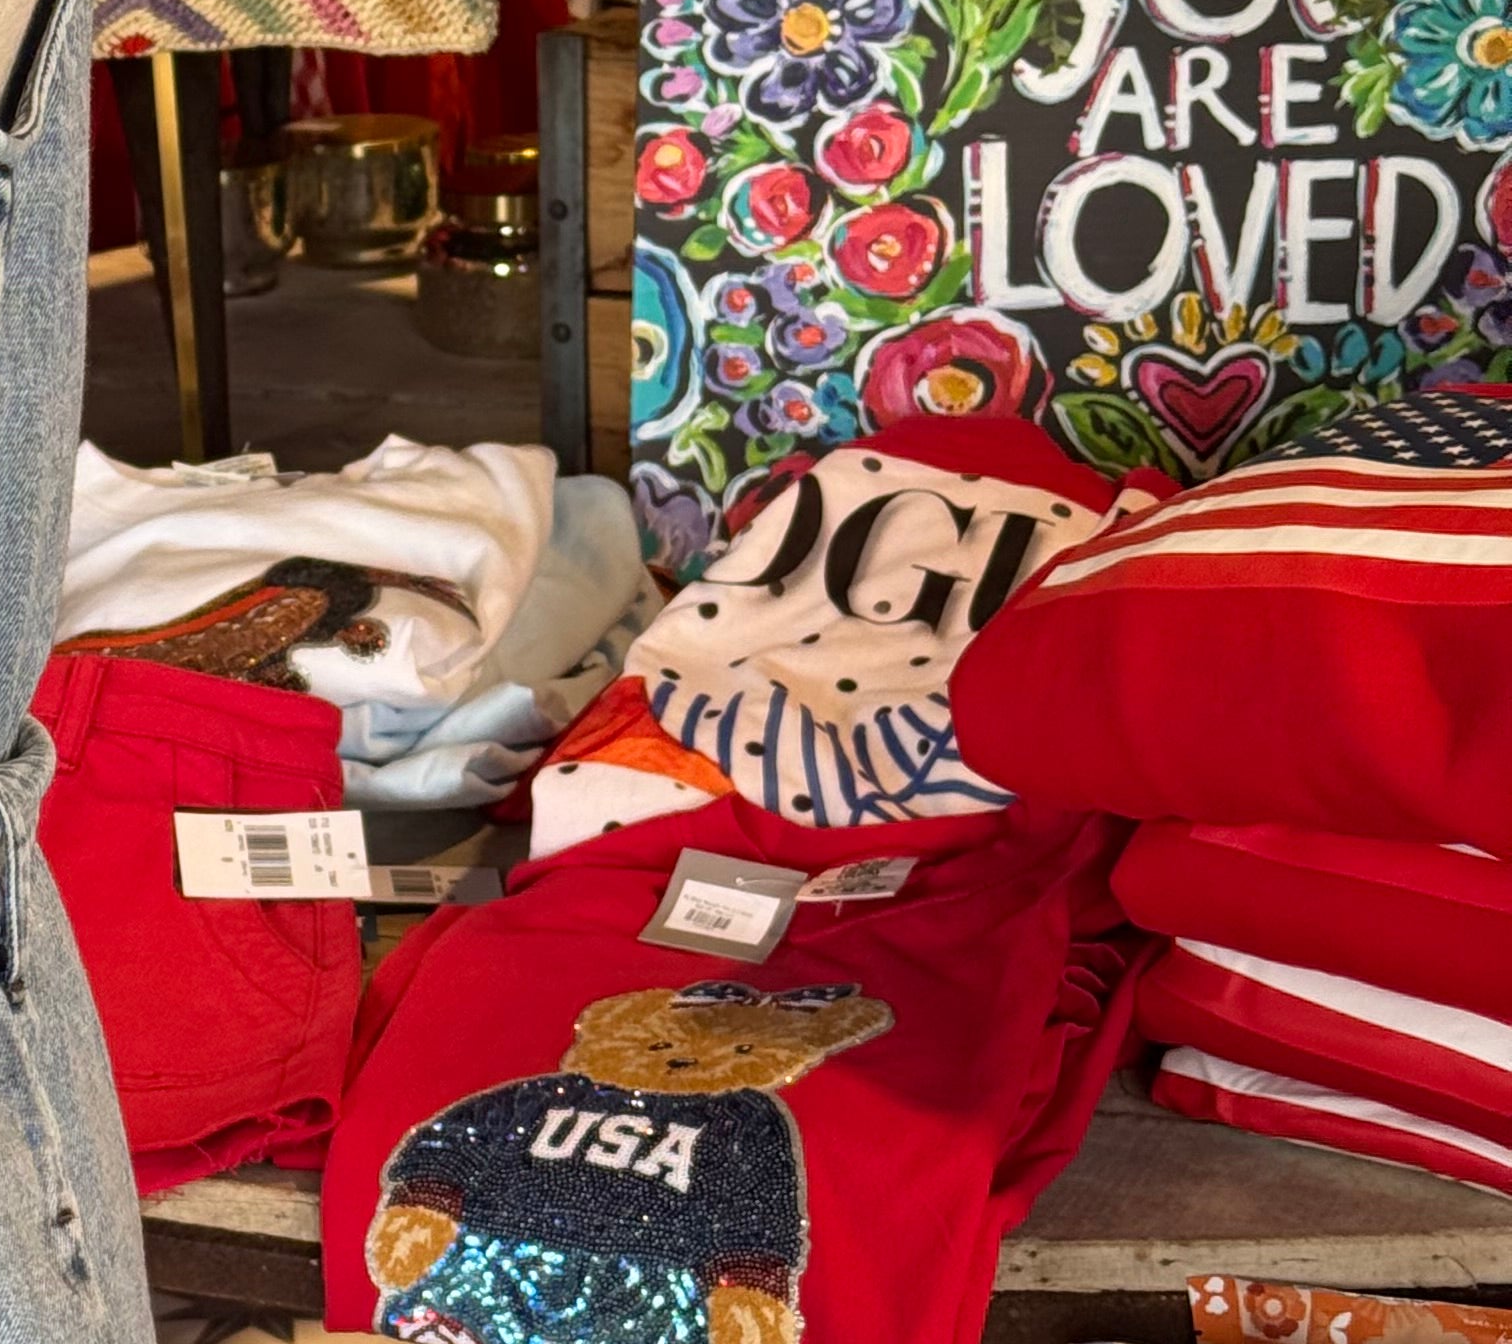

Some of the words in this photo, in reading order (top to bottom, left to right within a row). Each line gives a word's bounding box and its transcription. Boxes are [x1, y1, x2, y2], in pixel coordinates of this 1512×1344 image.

[1068, 42, 1339, 156] ARE
[962, 134, 1460, 326] LOVED
[529, 1105, 707, 1194] USA
